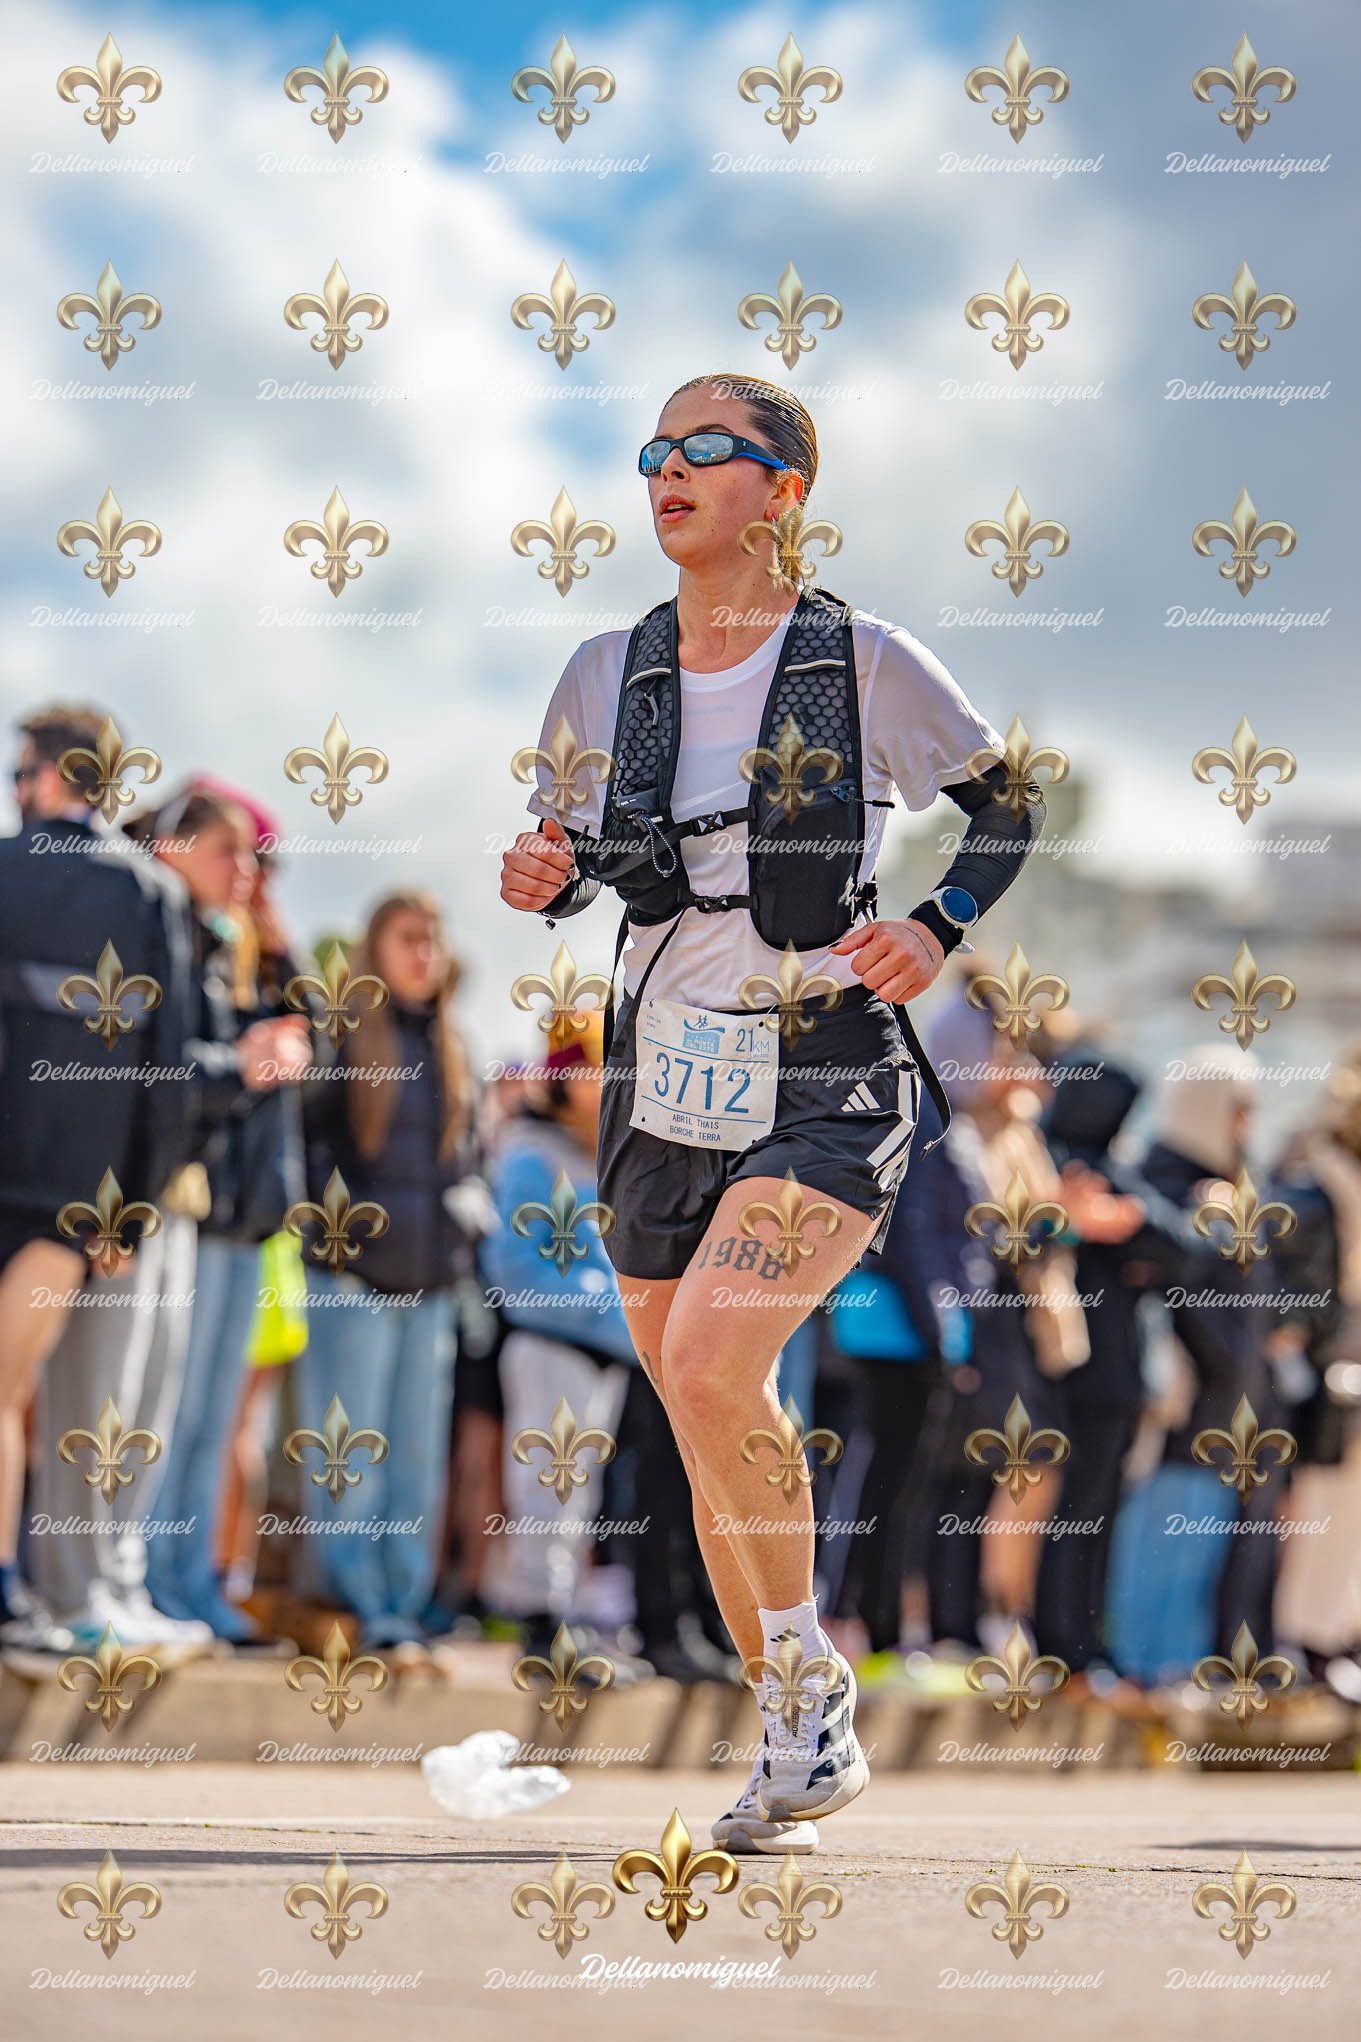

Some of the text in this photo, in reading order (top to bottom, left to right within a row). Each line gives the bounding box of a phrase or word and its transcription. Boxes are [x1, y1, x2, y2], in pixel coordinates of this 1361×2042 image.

[654, 1052, 751, 1114] 3712
[669, 1125, 721, 1142] BORCHE TERRA
[672, 1113, 720, 1130] ABRIL THAIS
[791, 1706, 800, 1738] ADIZERO
